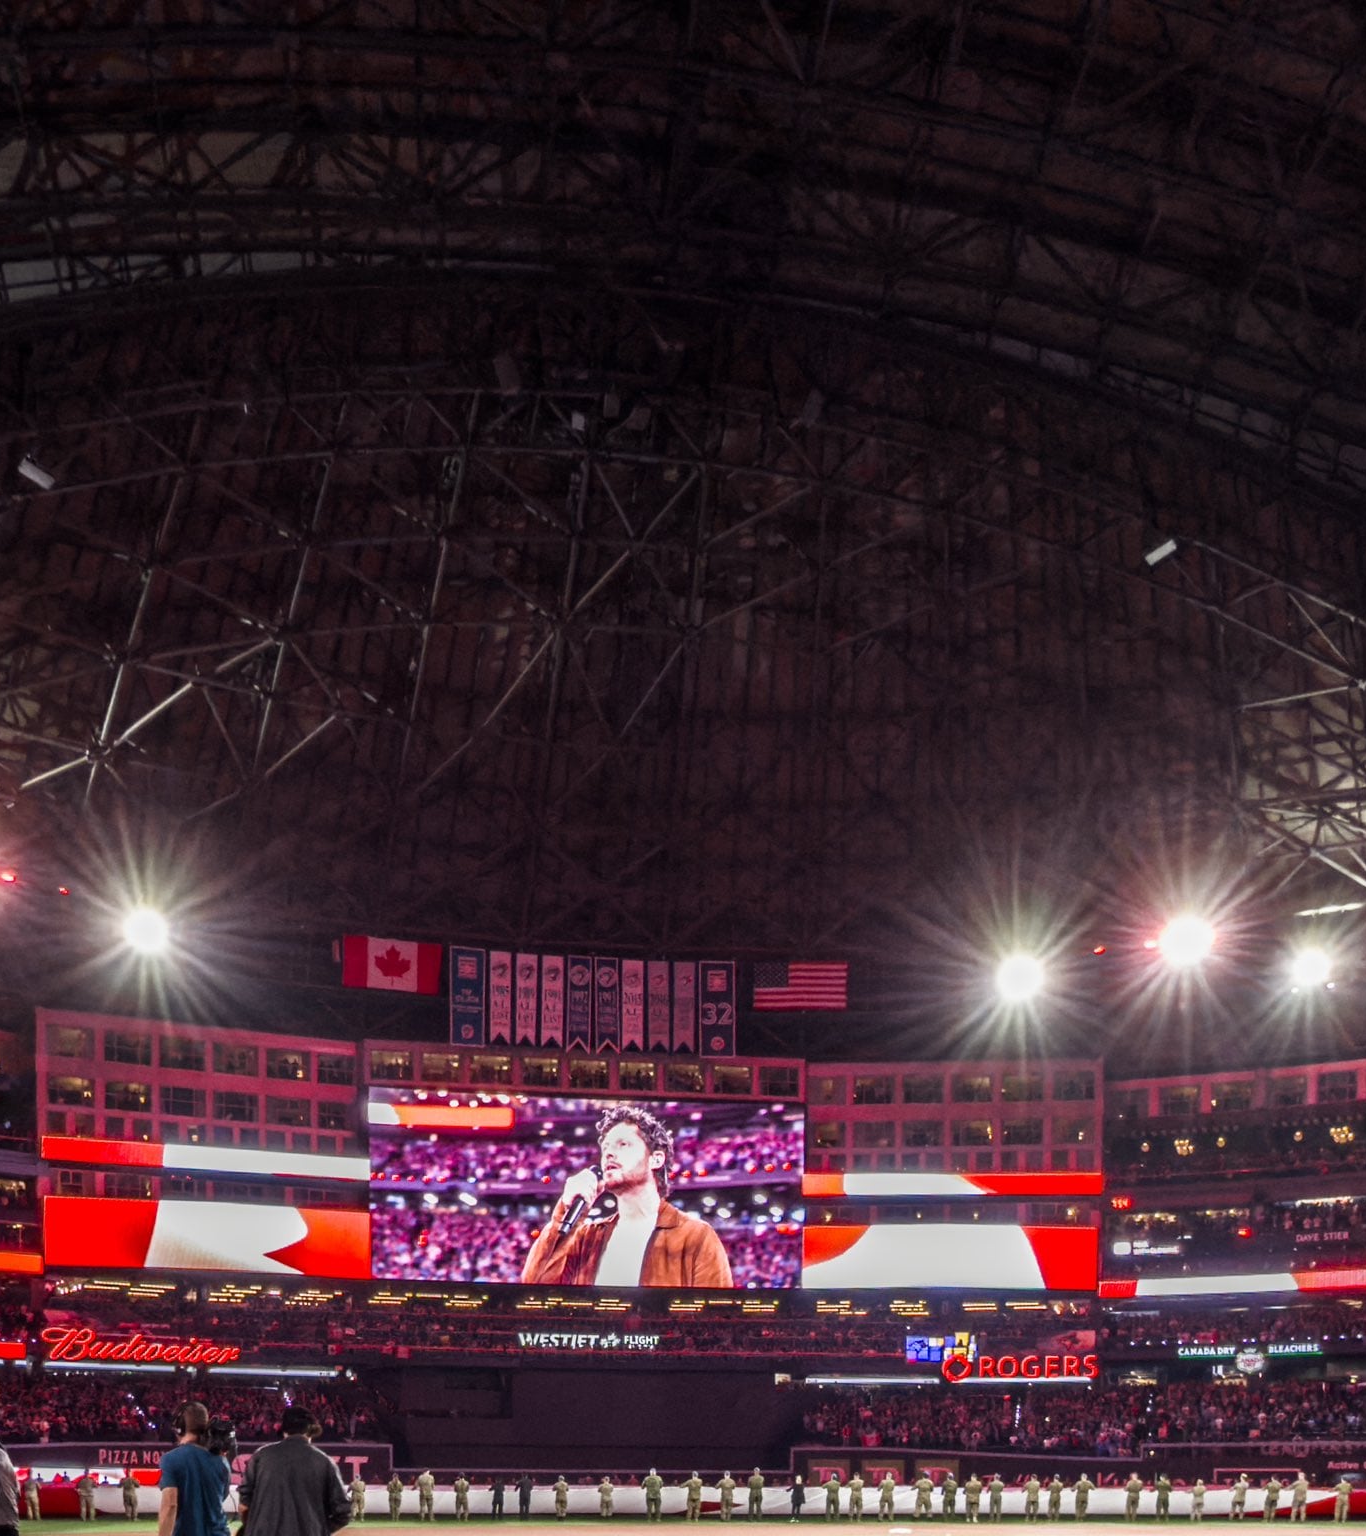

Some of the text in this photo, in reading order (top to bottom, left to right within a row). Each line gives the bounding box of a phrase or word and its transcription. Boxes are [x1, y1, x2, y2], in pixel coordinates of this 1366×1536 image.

[702, 1002, 733, 1026] 32
[1295, 1231, 1349, 1243] DAVE STIEB
[41, 1327, 241, 1364] Budweiser
[624, 1335, 660, 1345] FLIGHT
[1178, 1344, 1320, 1356] CANADA DRY BLEACHERS
[979, 1354, 1099, 1379] ROGERS
[98, 1449, 138, 1465] PIZZA
[1327, 1461, 1359, 1470] Active
